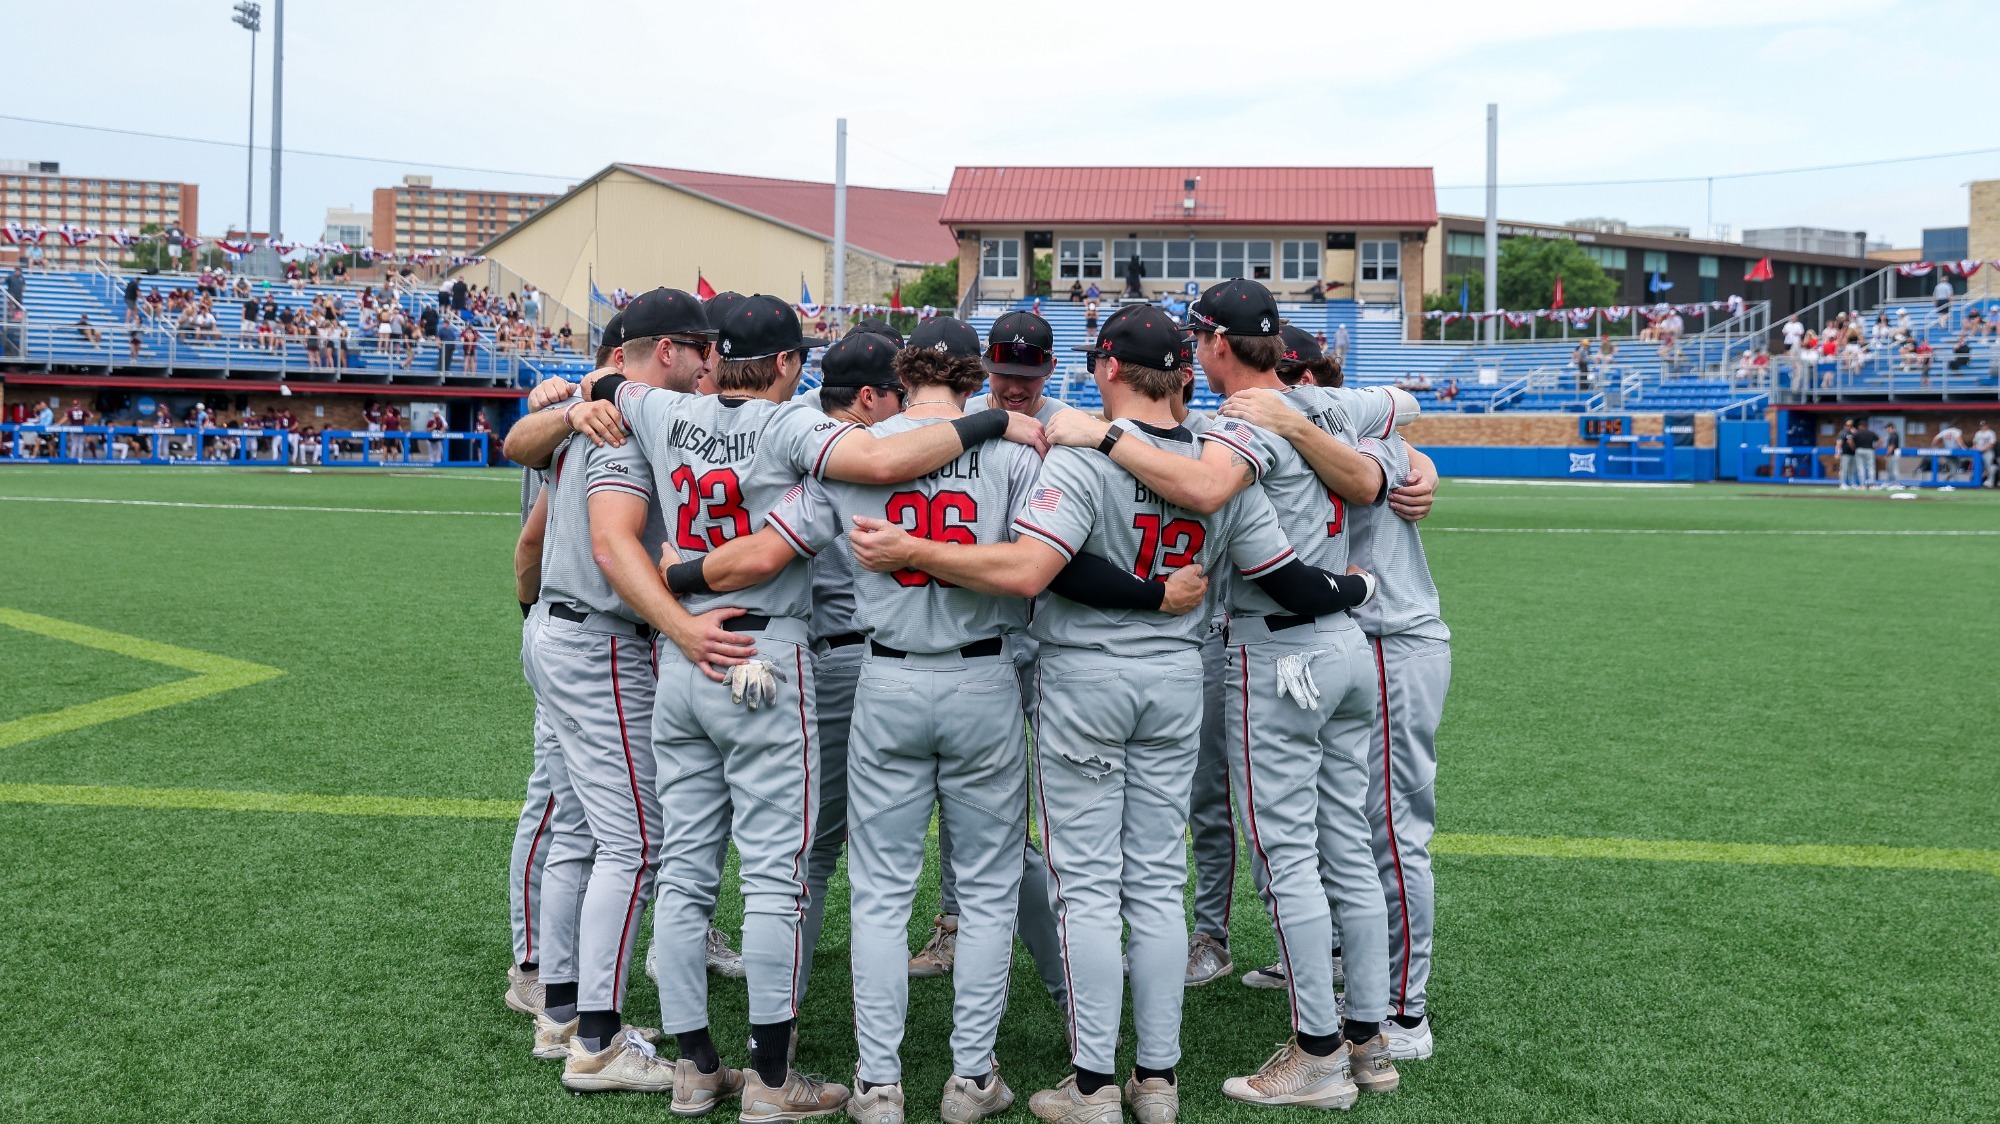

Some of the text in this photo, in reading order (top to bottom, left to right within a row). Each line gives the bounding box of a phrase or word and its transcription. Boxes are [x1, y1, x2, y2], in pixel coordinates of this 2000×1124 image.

[668, 418, 757, 465] MUSACCHIA
[814, 421, 837, 432] CAA
[604, 461, 629, 475] CAA
[671, 462, 753, 552] 23
